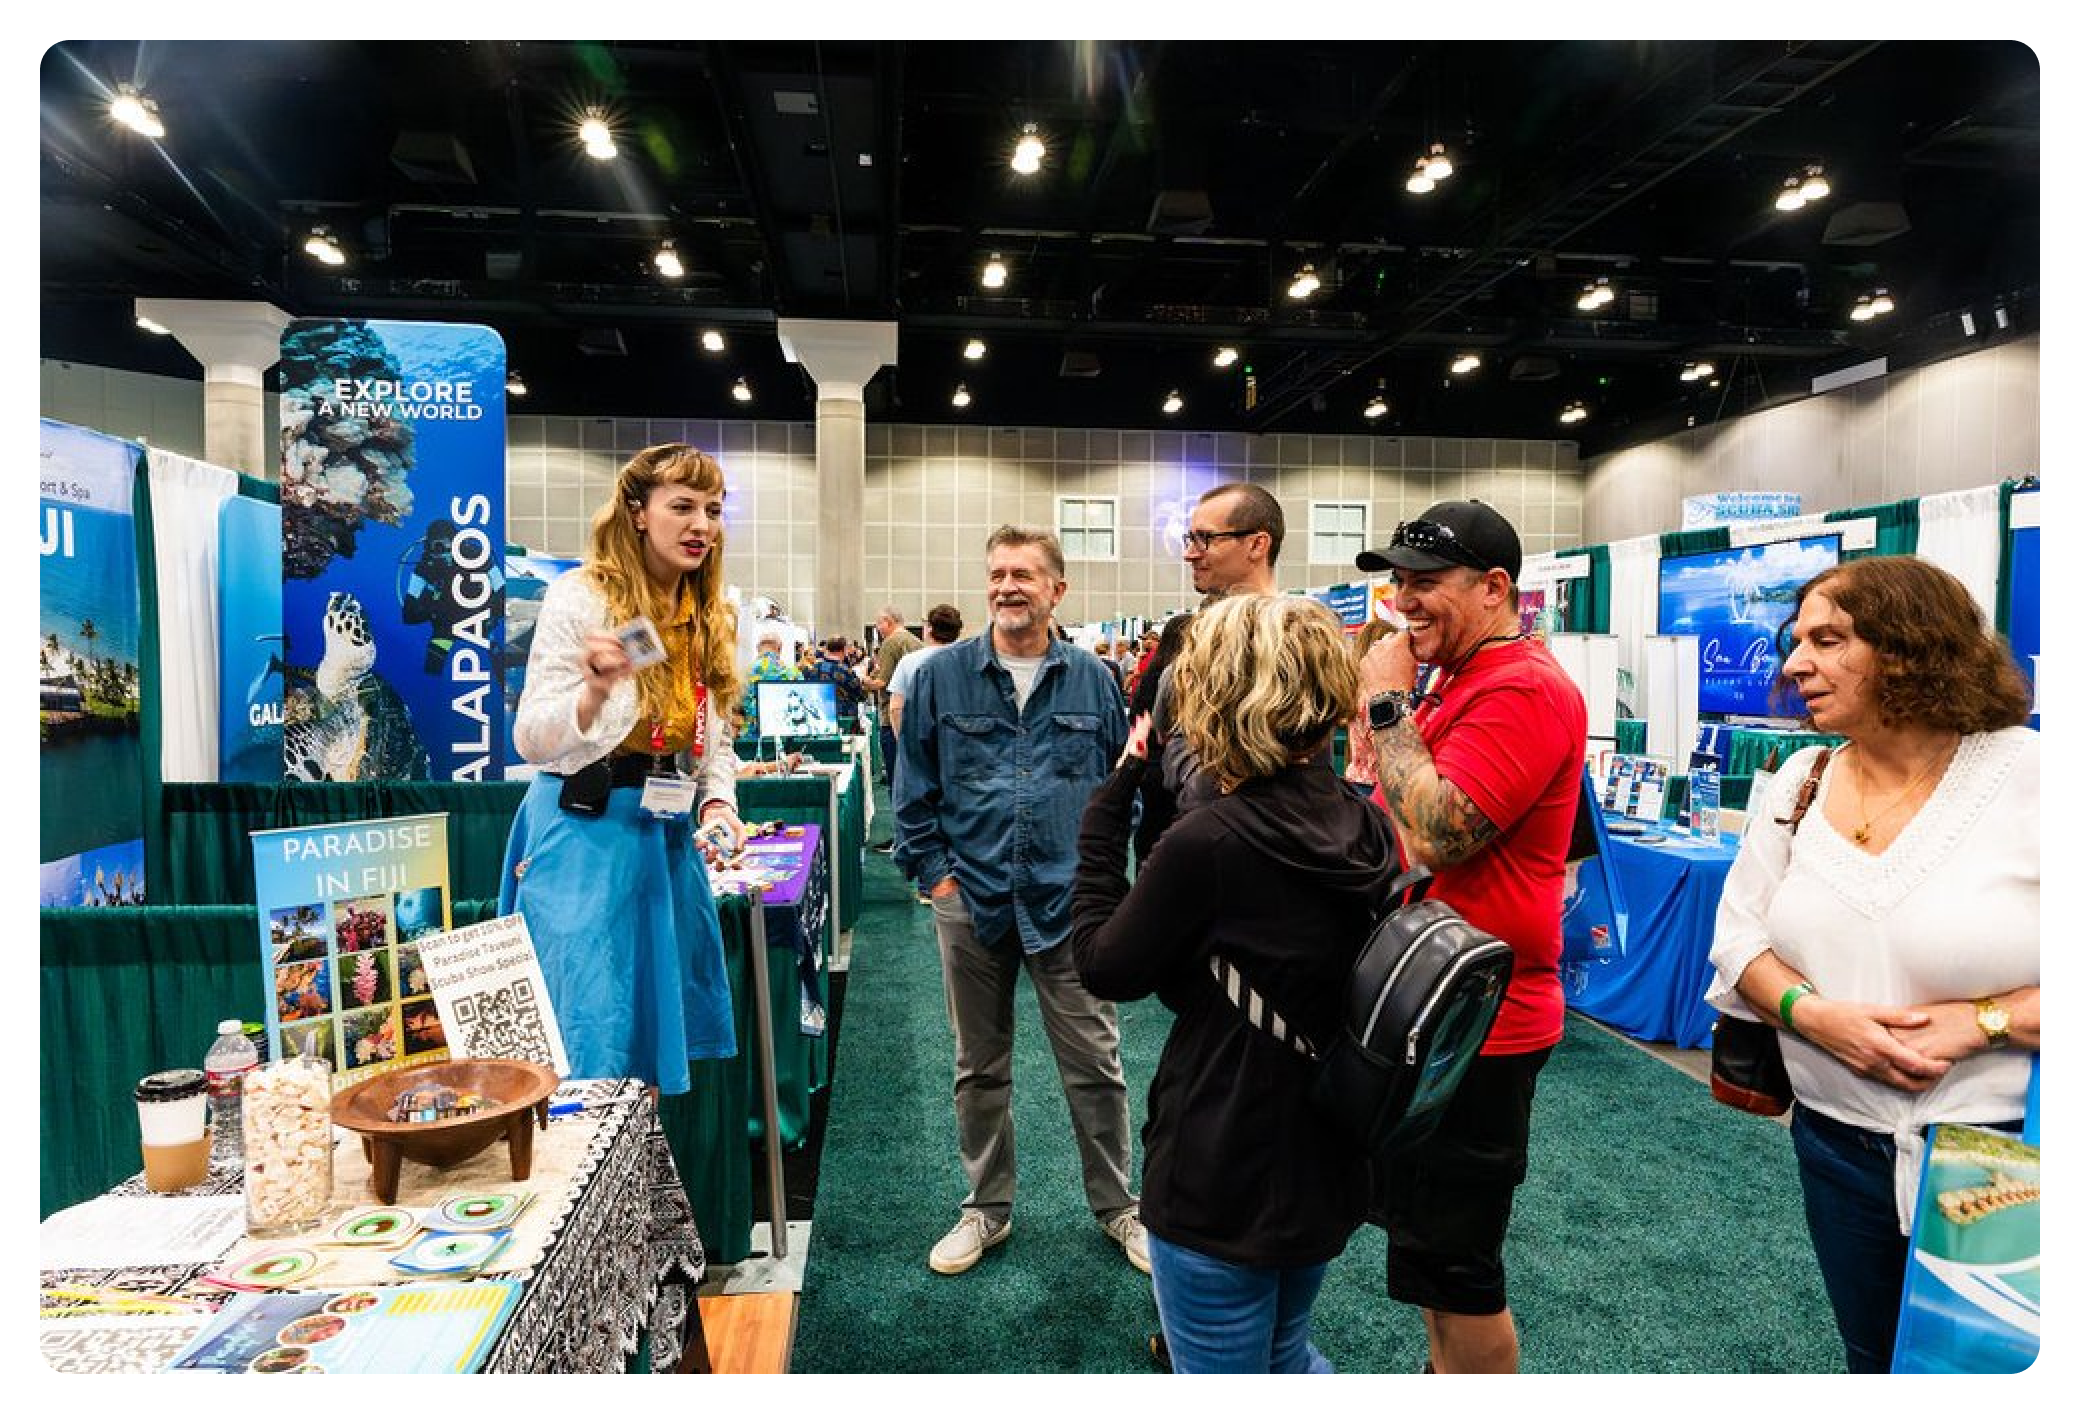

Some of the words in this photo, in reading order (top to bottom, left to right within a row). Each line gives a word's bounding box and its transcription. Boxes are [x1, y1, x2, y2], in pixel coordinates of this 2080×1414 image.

[335, 379, 473, 402] EXPLORE
[319, 401, 333, 417] A
[341, 402, 392, 418] NEW
[400, 404, 483, 420] WORLD
[283, 824, 432, 863] PARADISE
[315, 871, 349, 897] IN
[361, 864, 407, 893] FIJI
[419, 937, 446, 952] Scan
[448, 934, 460, 944] to
[463, 927, 480, 942] get
[432, 947, 480, 966] Paradise
[430, 972, 465, 990] Scuba
[466, 963, 495, 979] Show
[495, 950, 534, 971] Special
